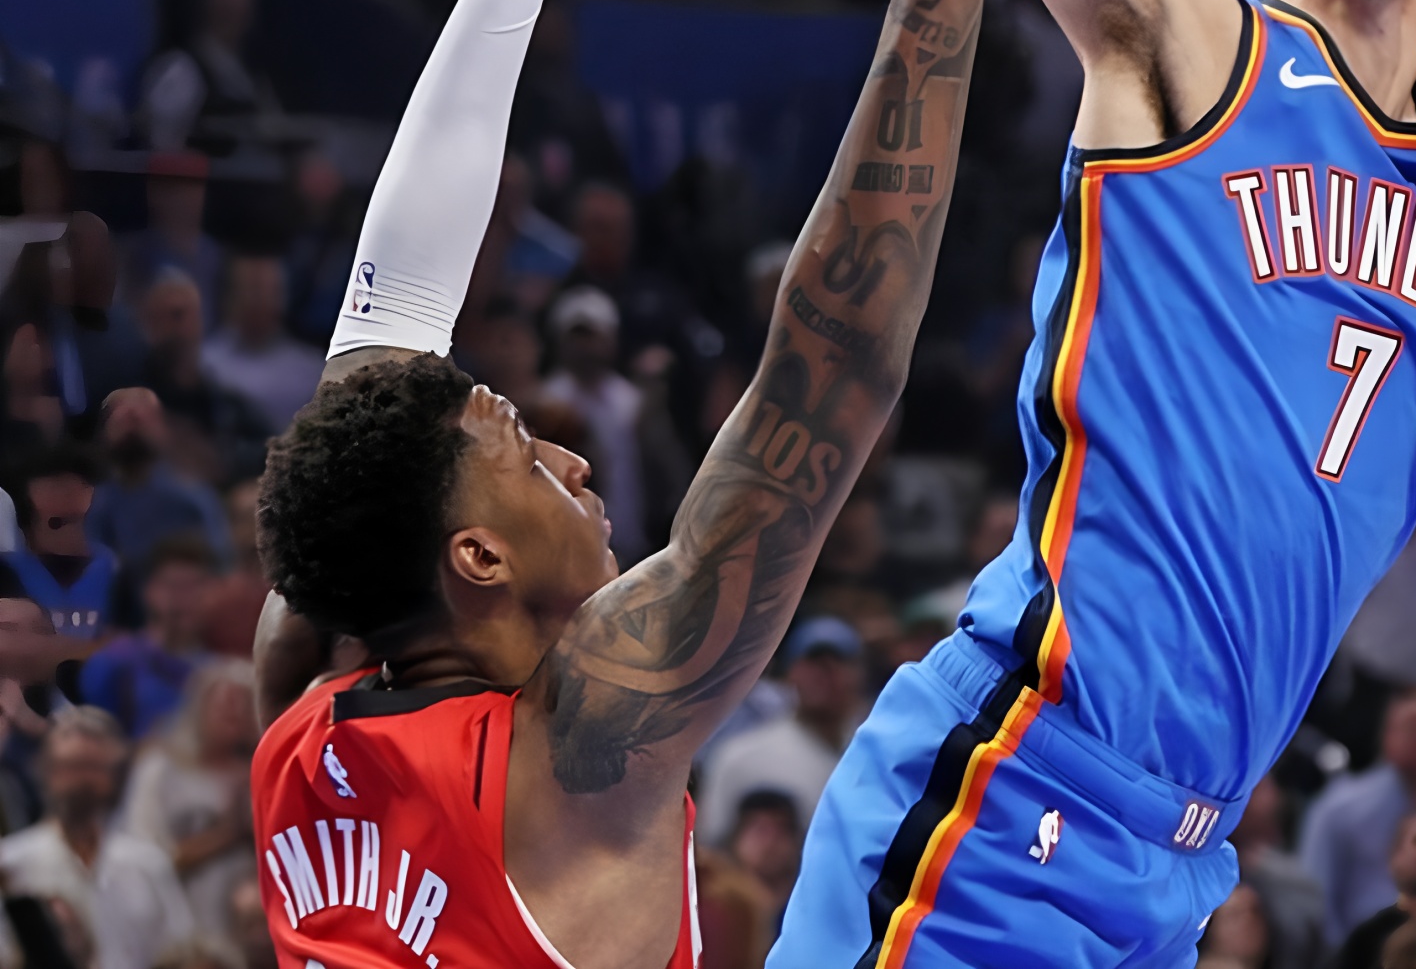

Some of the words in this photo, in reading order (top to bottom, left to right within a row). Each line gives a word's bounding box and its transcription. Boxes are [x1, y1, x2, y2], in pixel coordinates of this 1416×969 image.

[1314, 315, 1405, 483] 7
[266, 817, 381, 931] SMITH
[385, 849, 449, 969] JR.
